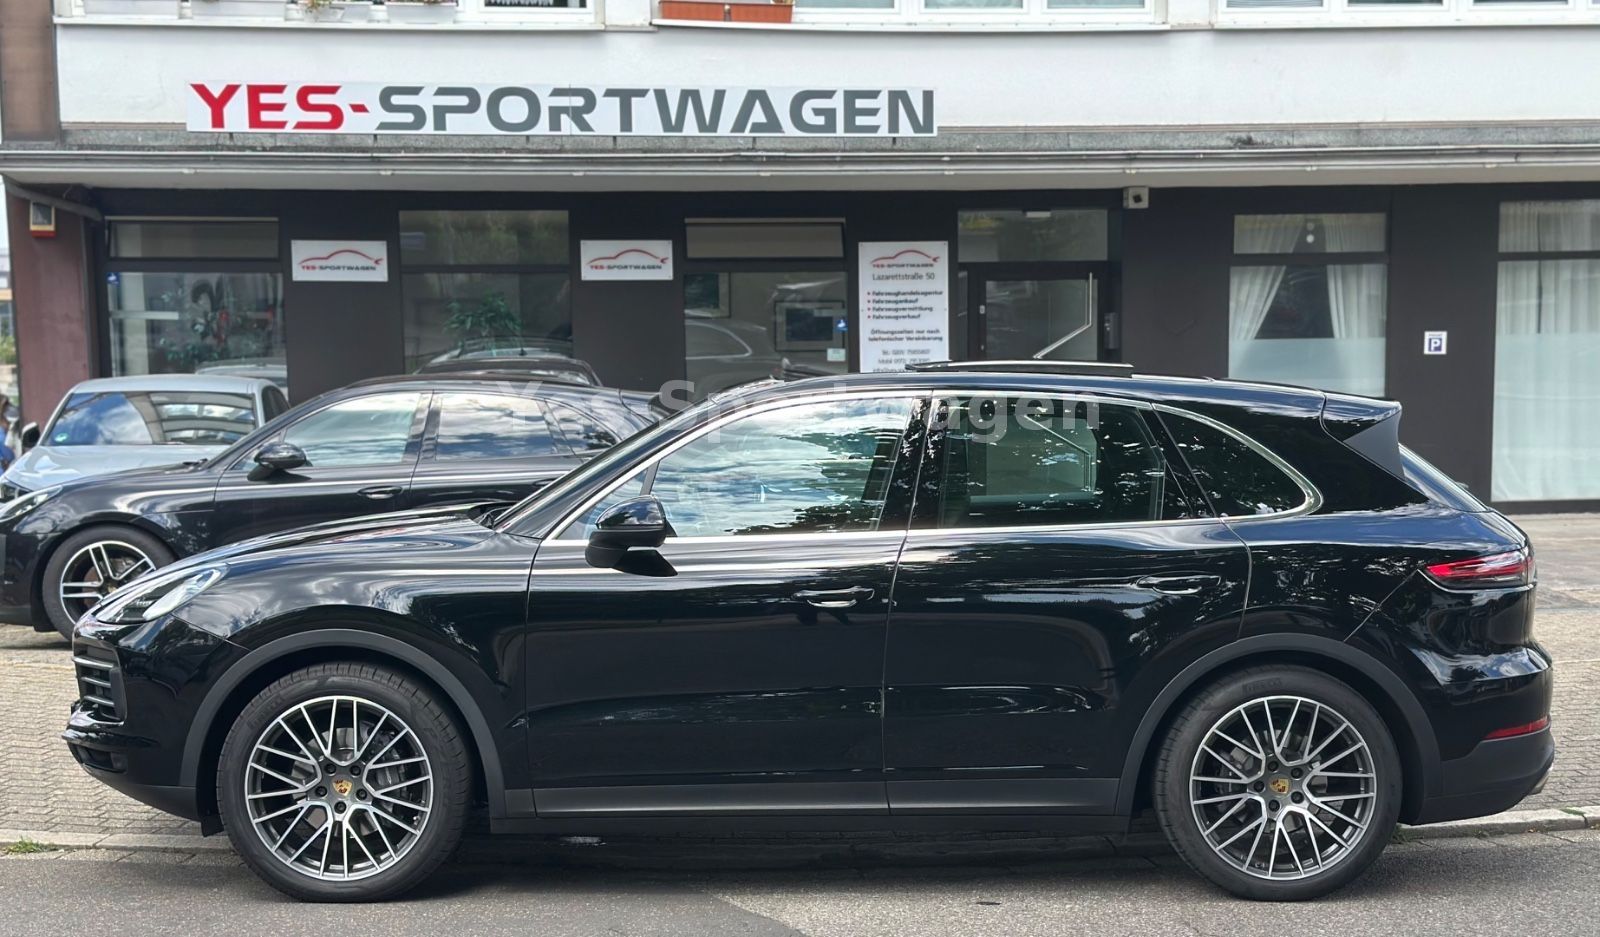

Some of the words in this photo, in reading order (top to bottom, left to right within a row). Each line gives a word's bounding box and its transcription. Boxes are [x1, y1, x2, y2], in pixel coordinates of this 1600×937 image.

[190, 83, 934, 134] YES-SPORTWAGEN
[872, 272, 923, 281] Lazarettstraße
[926, 273, 935, 281] 50
